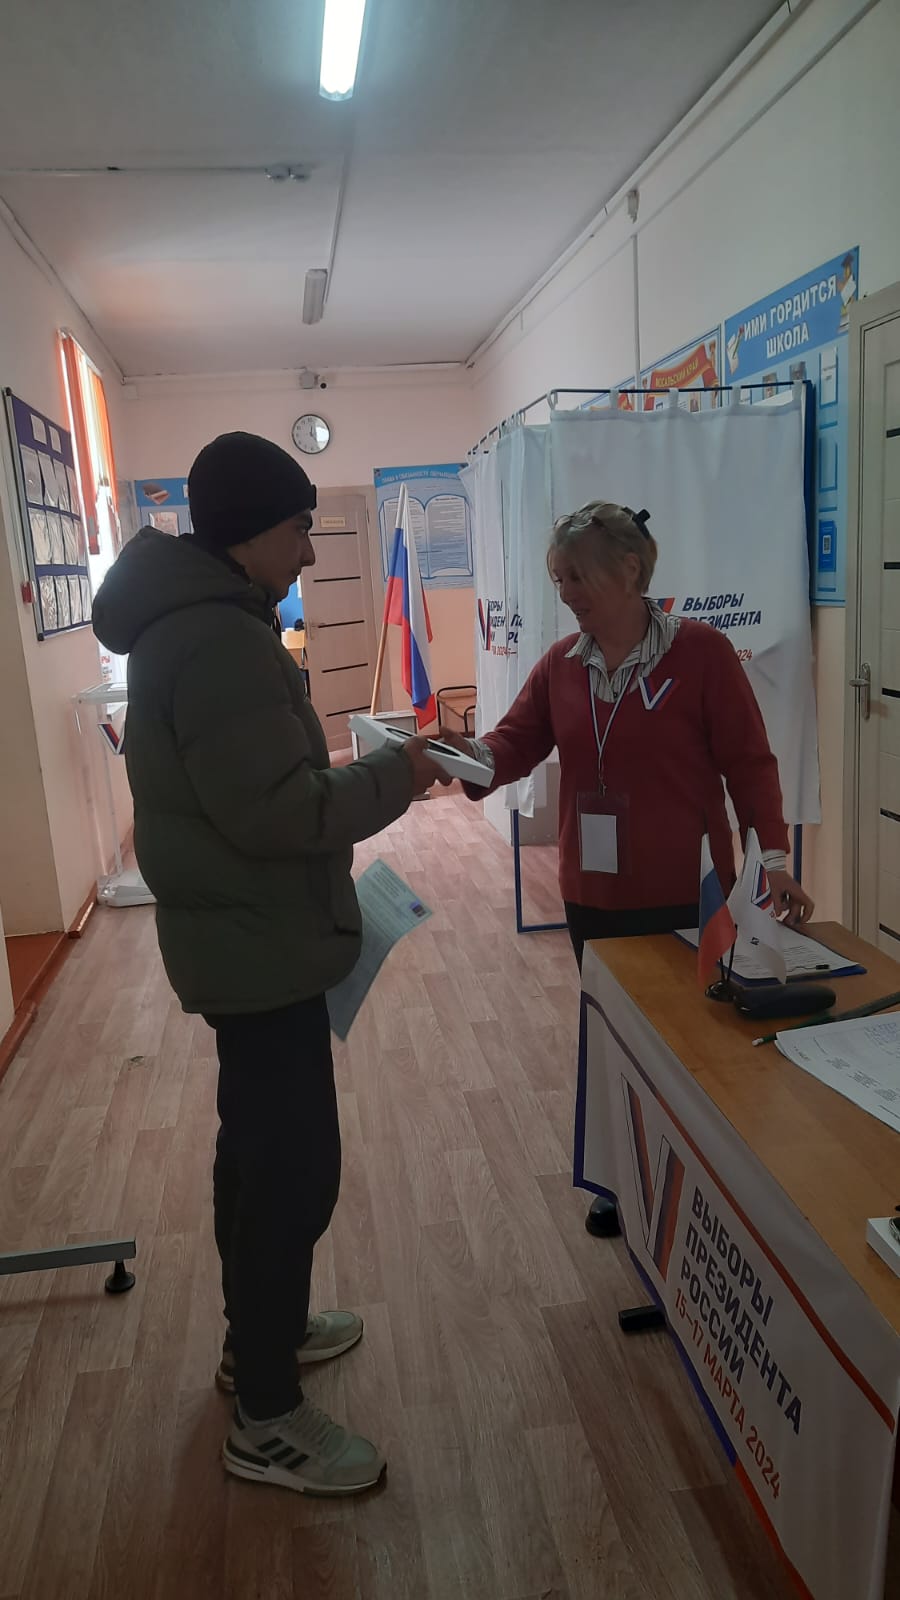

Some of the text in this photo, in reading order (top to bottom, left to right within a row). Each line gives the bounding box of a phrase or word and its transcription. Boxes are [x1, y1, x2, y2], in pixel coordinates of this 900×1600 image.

[744, 274, 838, 341] ИМИ ГОРДИТСЯ
[766, 322, 809, 359] ШКОЛА
[682, 593, 745, 612] ВЫБОРЫ
[680, 1255, 745, 1384] РОССИИ
[691, 1186, 774, 1326] ВЫБОРЫ
[685, 1221, 802, 1435] ПРЕЗИДЕНТА
[703, 1343, 746, 1433] МАРТА
[745, 1425, 781, 1500] 2024
